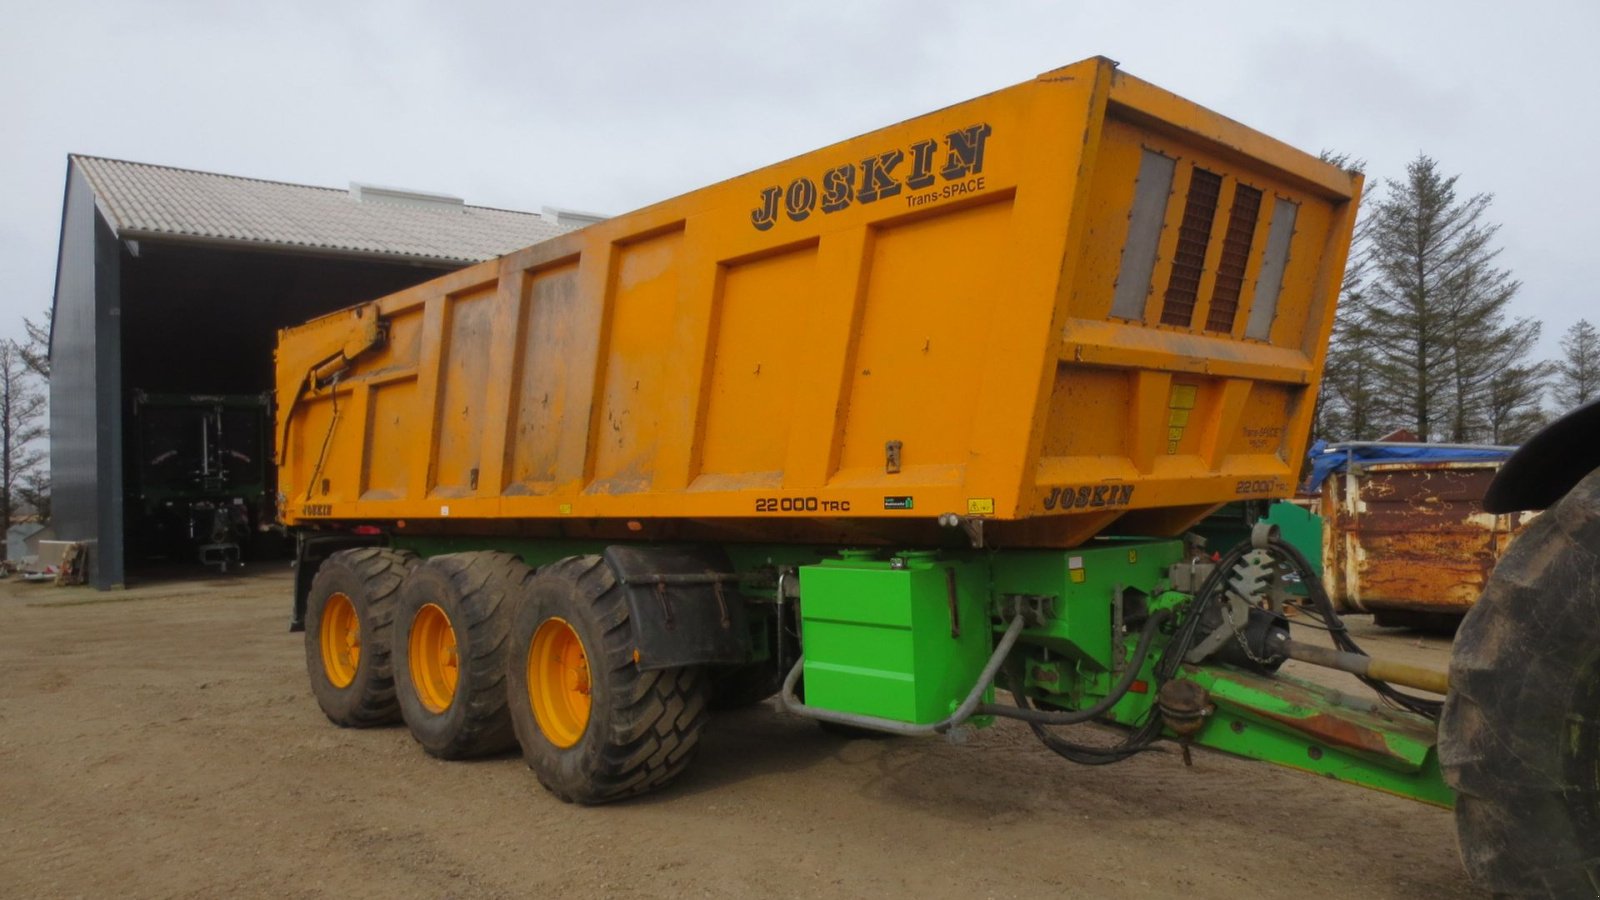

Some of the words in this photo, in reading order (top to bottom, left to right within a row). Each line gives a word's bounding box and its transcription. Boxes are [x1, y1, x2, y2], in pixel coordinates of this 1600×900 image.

[751, 123, 992, 231] JOSKIN
[906, 177, 985, 208] Trans-SPACE
[821, 501, 850, 511] TRC
[1044, 485, 1135, 510] JOSKIN
